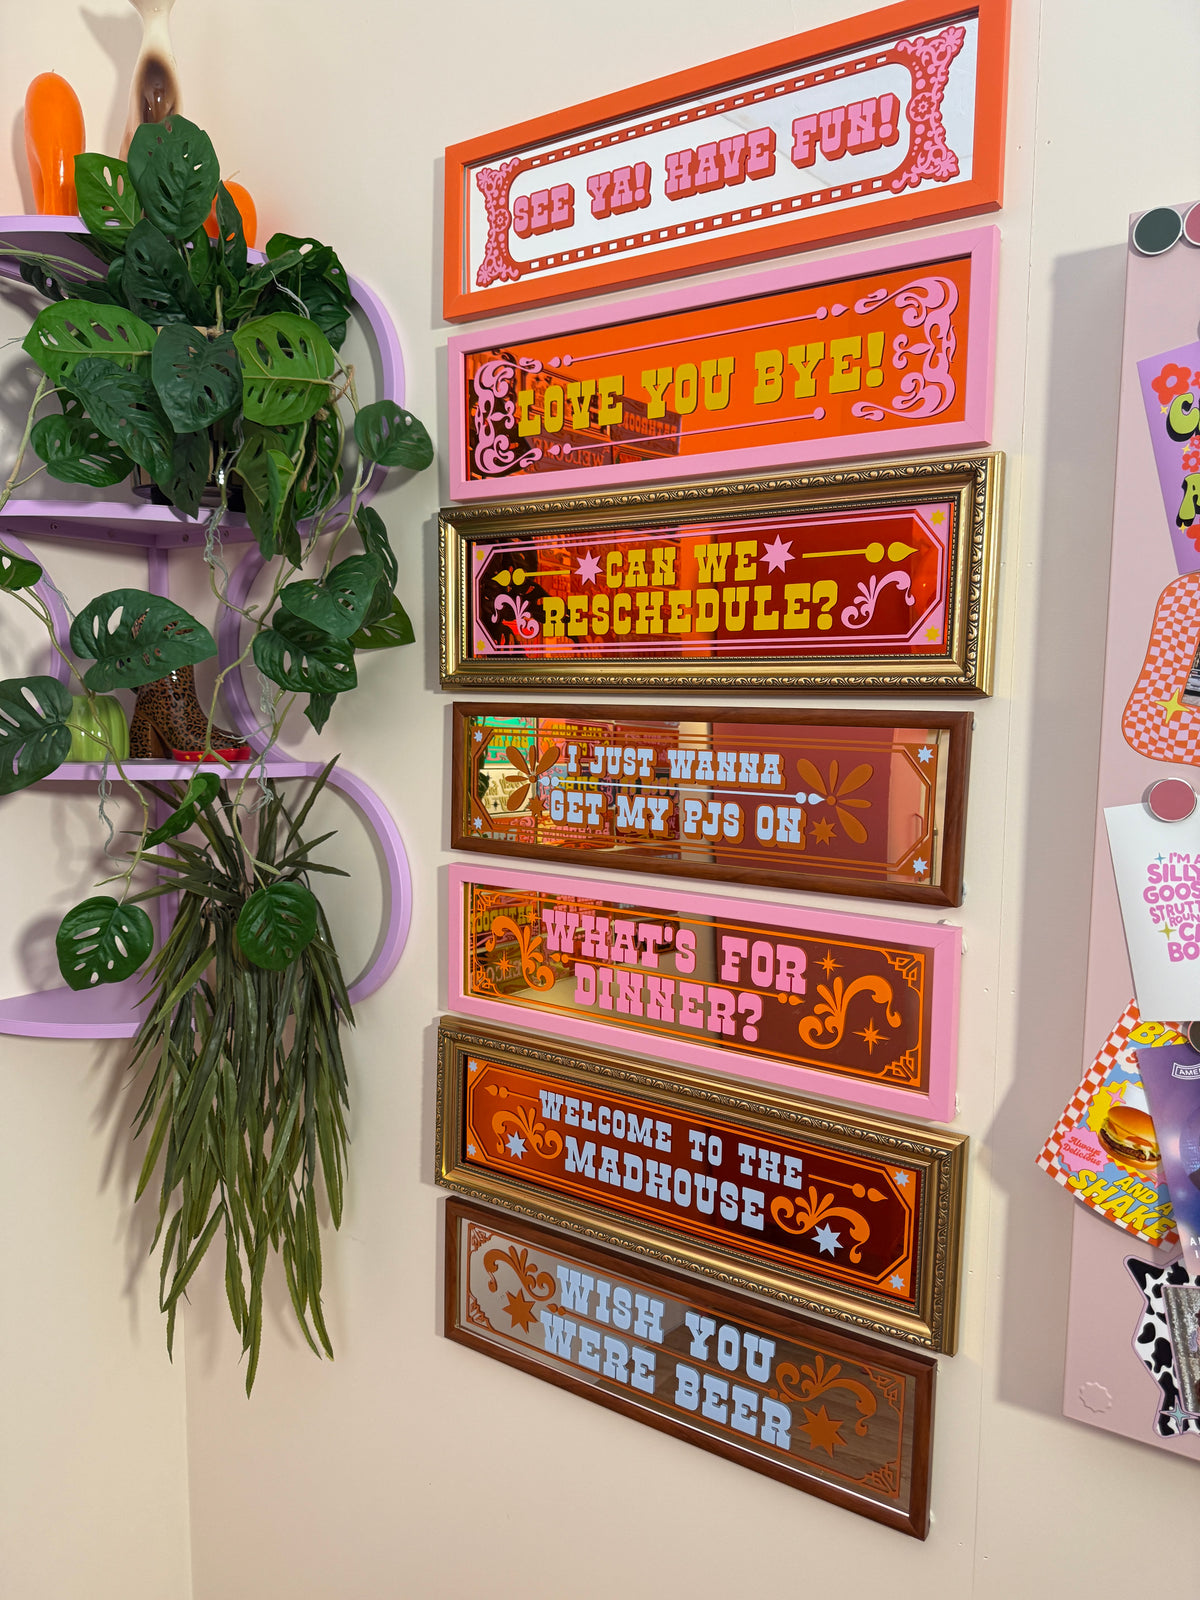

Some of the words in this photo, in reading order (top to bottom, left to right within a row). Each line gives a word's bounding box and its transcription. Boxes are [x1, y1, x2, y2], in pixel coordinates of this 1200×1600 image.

[513, 184, 572, 236] SEE
[588, 163, 650, 216] YA!
[665, 128, 774, 197] HAVE
[793, 95, 897, 165] FUN!
[518, 374, 623, 437] LOVE
[641, 356, 734, 420] YOU
[753, 331, 885, 404] BYE!
[606, 546, 676, 589] CAN
[693, 540, 758, 584] WE
[542, 580, 838, 637] RESCHEDULE?
[567, 745, 578, 772] I
[590, 746, 653, 777] JUST
[667, 750, 781, 785] WANNA
[551, 790, 602, 825] GET
[617, 795, 669, 831] MY
[684, 800, 739, 837] PJS
[756, 805, 801, 843] ON
[1169, 852, 1190, 864] I'M
[542, 908, 697, 974] WHAT'S
[721, 936, 806, 995] FOR
[574, 962, 765, 1042] DINNER?
[539, 1090, 672, 1154] WELCOME
[689, 1130, 722, 1166] TO
[739, 1143, 802, 1188] THE
[1063, 1143, 1101, 1165] Delicious
[1068, 1136, 1101, 1157] Always
[565, 1136, 766, 1231] MADHOUSE
[1067, 1169, 1177, 1240] SHAKE
[1114, 1176, 1159, 1204] AND
[1155, 1201, 1173, 1216] A
[555, 1266, 664, 1345] WISH
[683, 1312, 775, 1384] YOU
[540, 1308, 659, 1394] WERE
[675, 1362, 791, 1450] BEER
